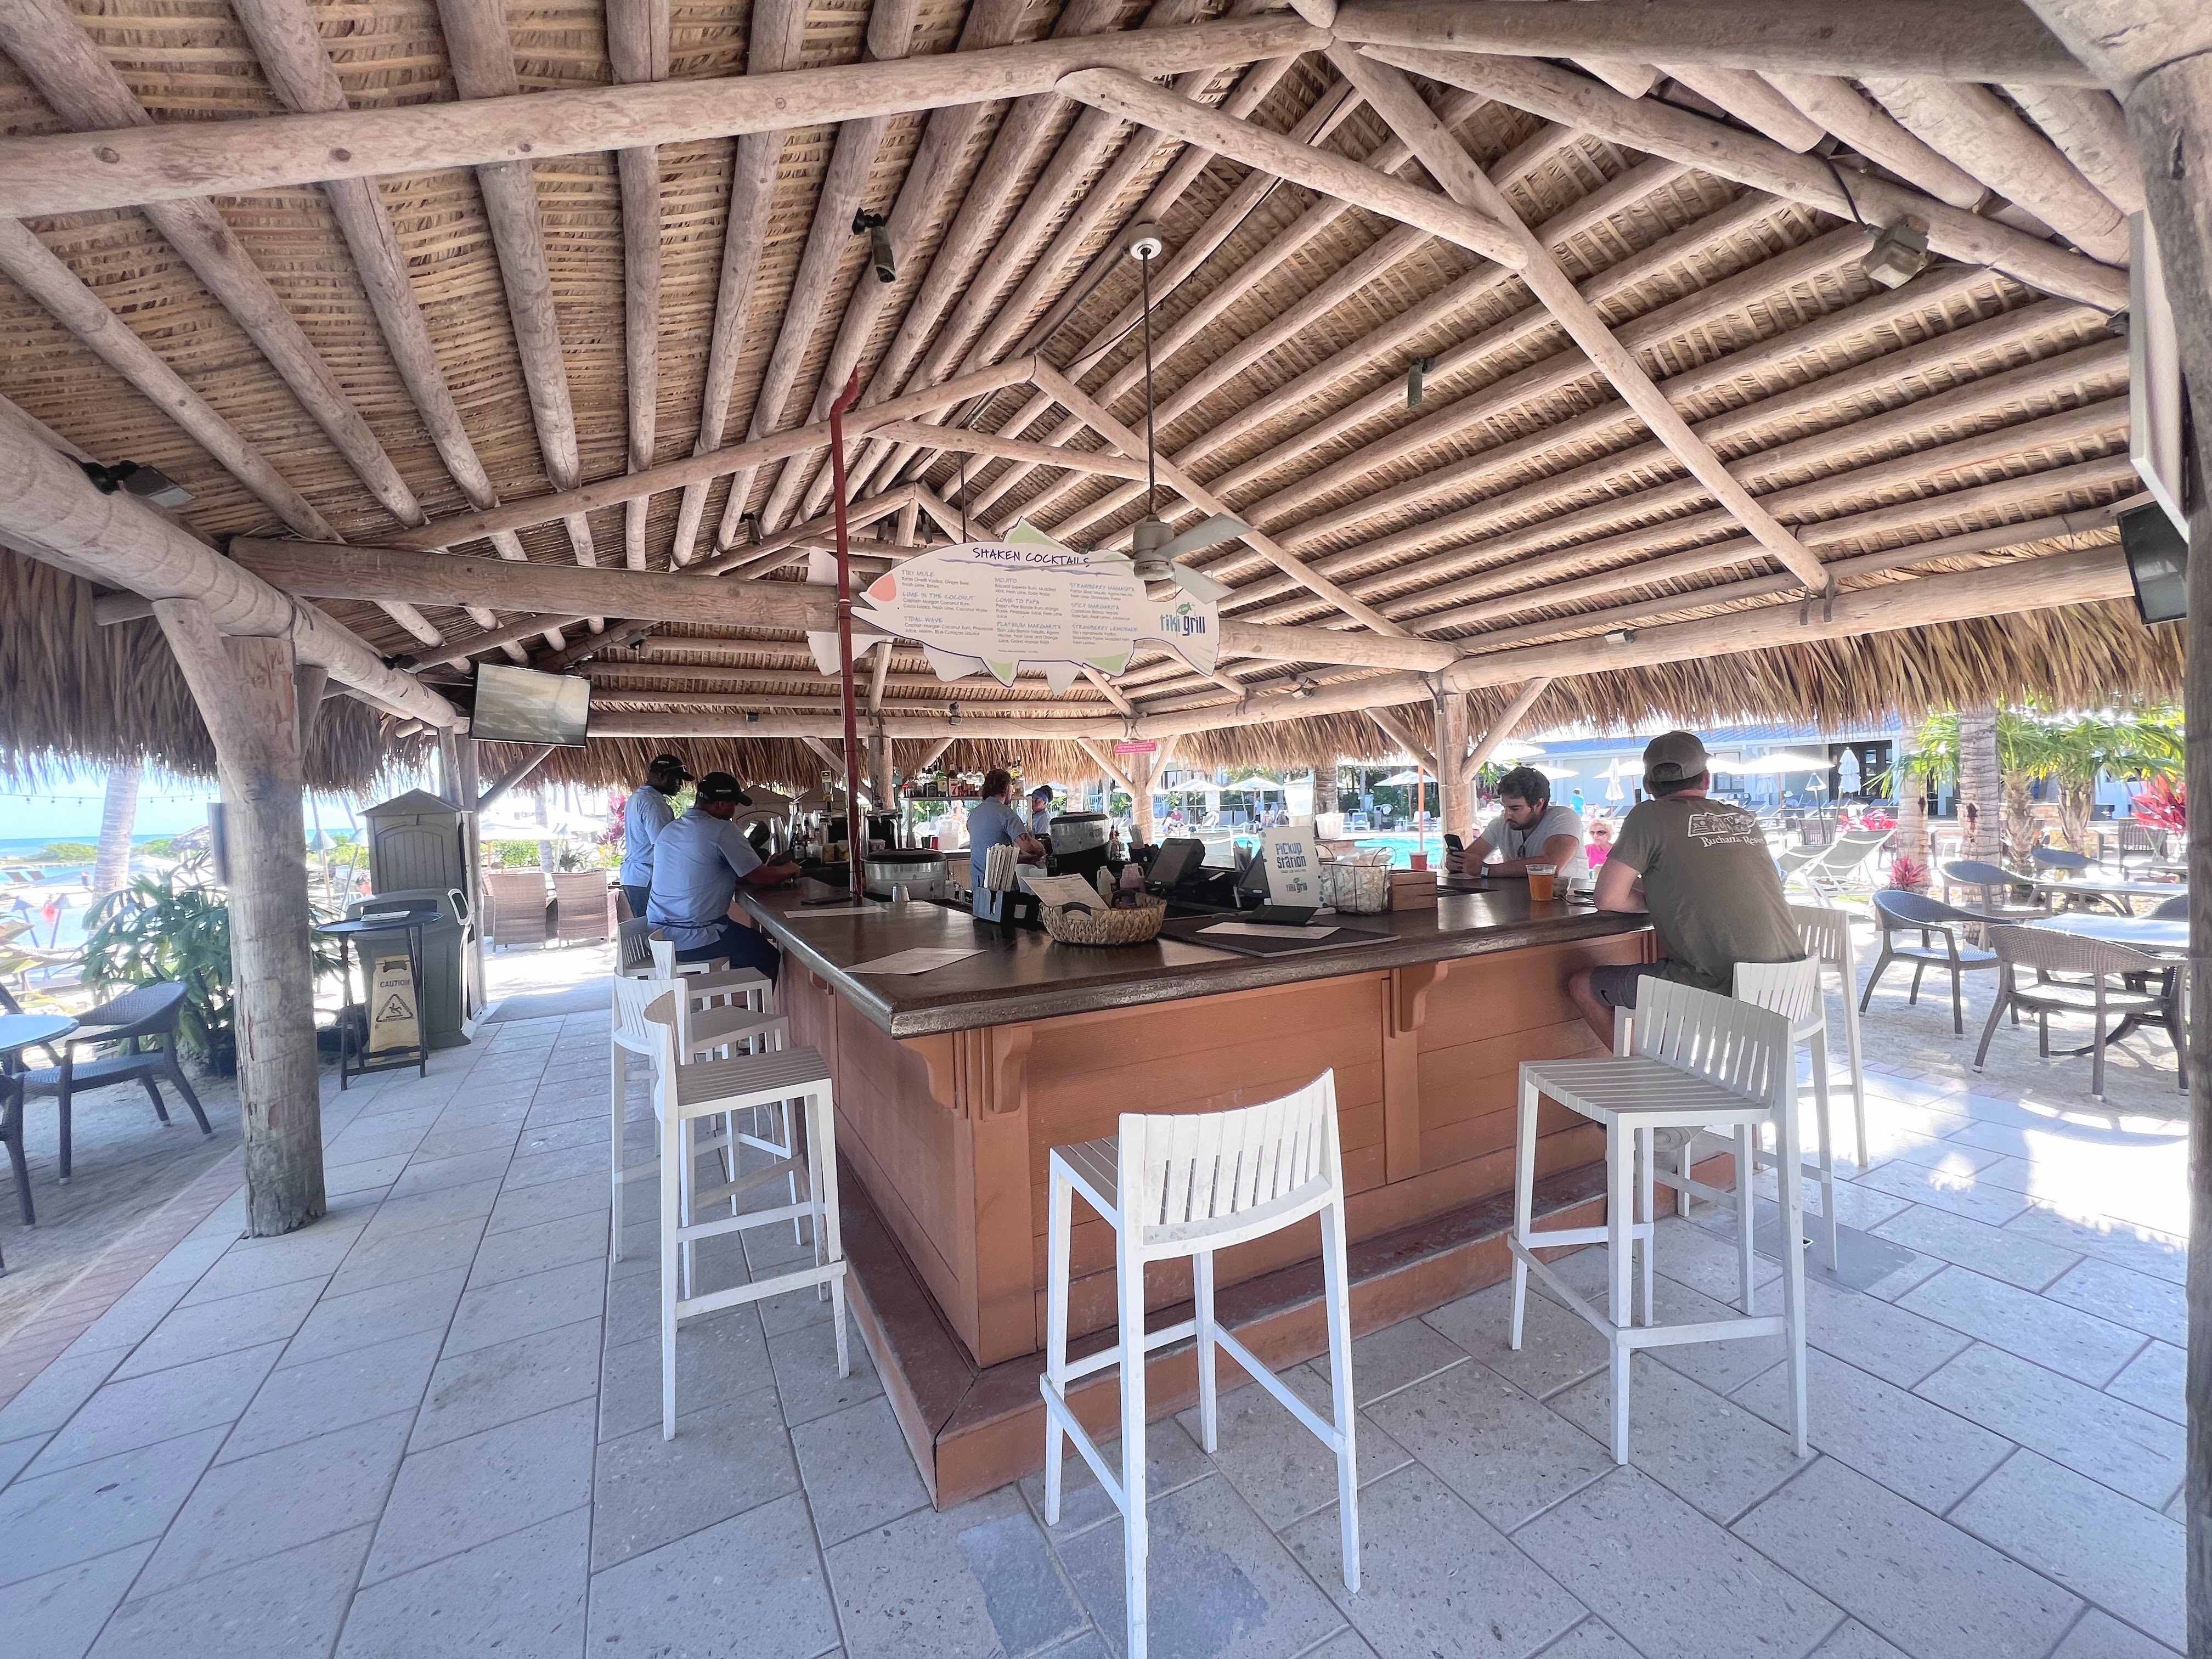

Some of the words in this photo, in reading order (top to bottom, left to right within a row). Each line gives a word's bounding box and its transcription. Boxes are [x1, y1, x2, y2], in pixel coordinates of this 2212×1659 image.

[973, 548, 1020, 561] SHAKEN
[1025, 552, 1090, 568] COCKTAILS
[1160, 614, 1181, 632] tiki
[1182, 616, 1205, 636] grill
[1277, 855, 1307, 868] station
[380, 979, 410, 988] CAUTION
